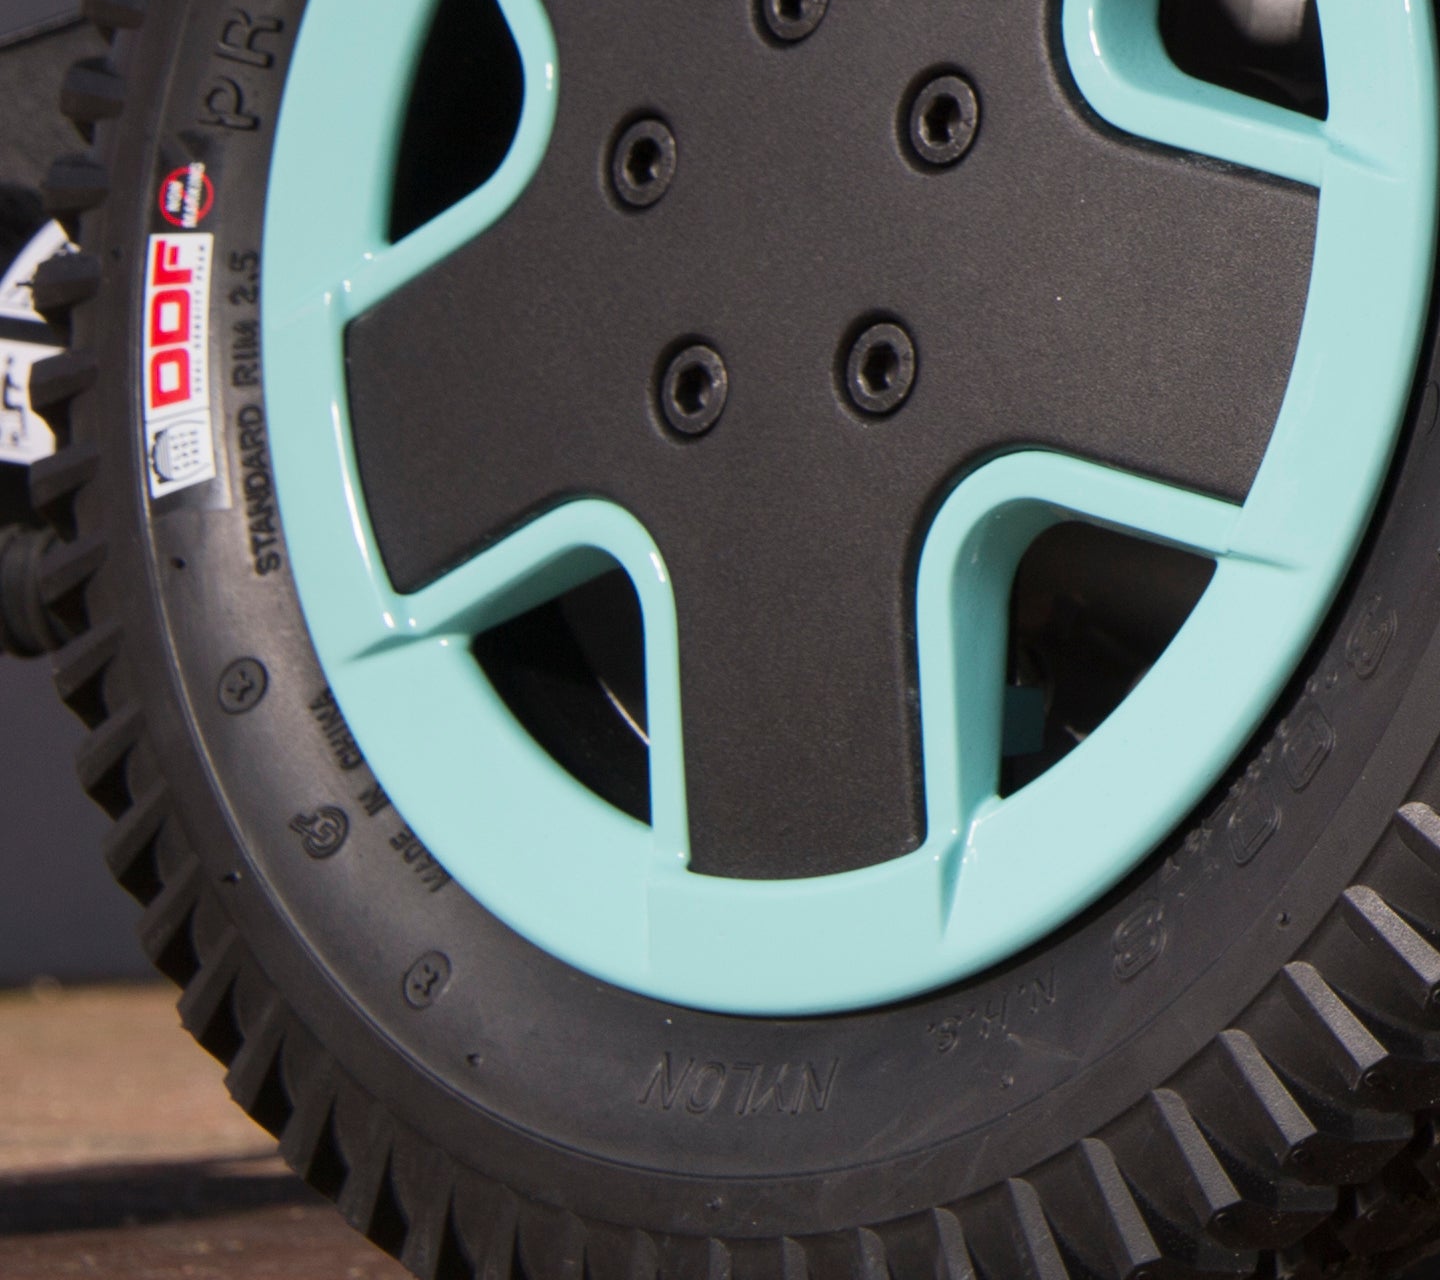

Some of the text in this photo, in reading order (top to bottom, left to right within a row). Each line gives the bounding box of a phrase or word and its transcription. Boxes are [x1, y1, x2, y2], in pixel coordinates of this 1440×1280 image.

[150, 239, 193, 409] DDF
[228, 248, 281, 576] STANDARD RIM 2.5
[308, 688, 366, 773] CHINA
[353, 781, 392, 819] IN
[637, 1051, 840, 1118] NYLON
